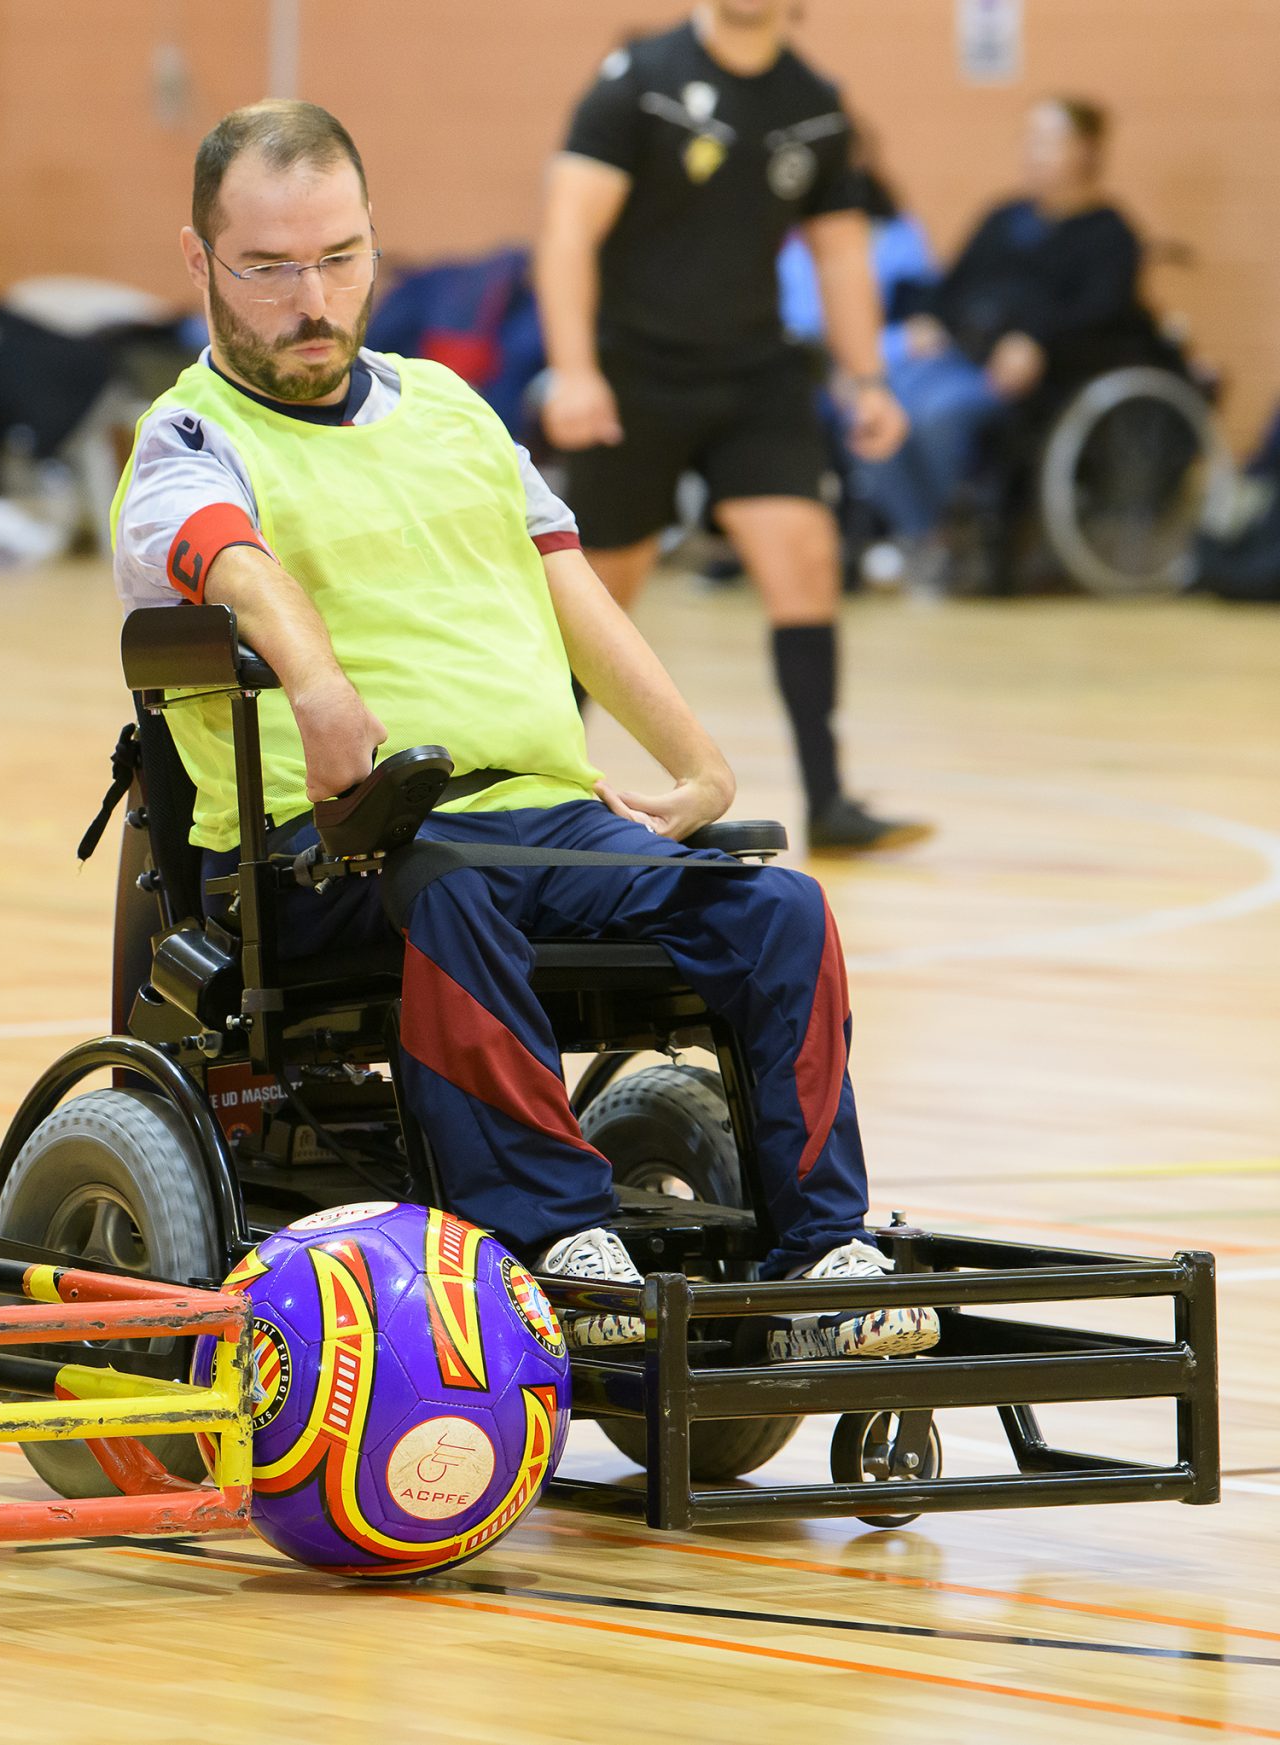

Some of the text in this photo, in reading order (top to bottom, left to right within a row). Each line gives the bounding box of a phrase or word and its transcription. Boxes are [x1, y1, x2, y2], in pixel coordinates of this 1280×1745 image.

[172, 540, 203, 592] C
[221, 1091, 238, 1107] UD
[253, 1321, 290, 1428] ANT FUTBOL SAL
[400, 1488, 470, 1505] ACPFE
